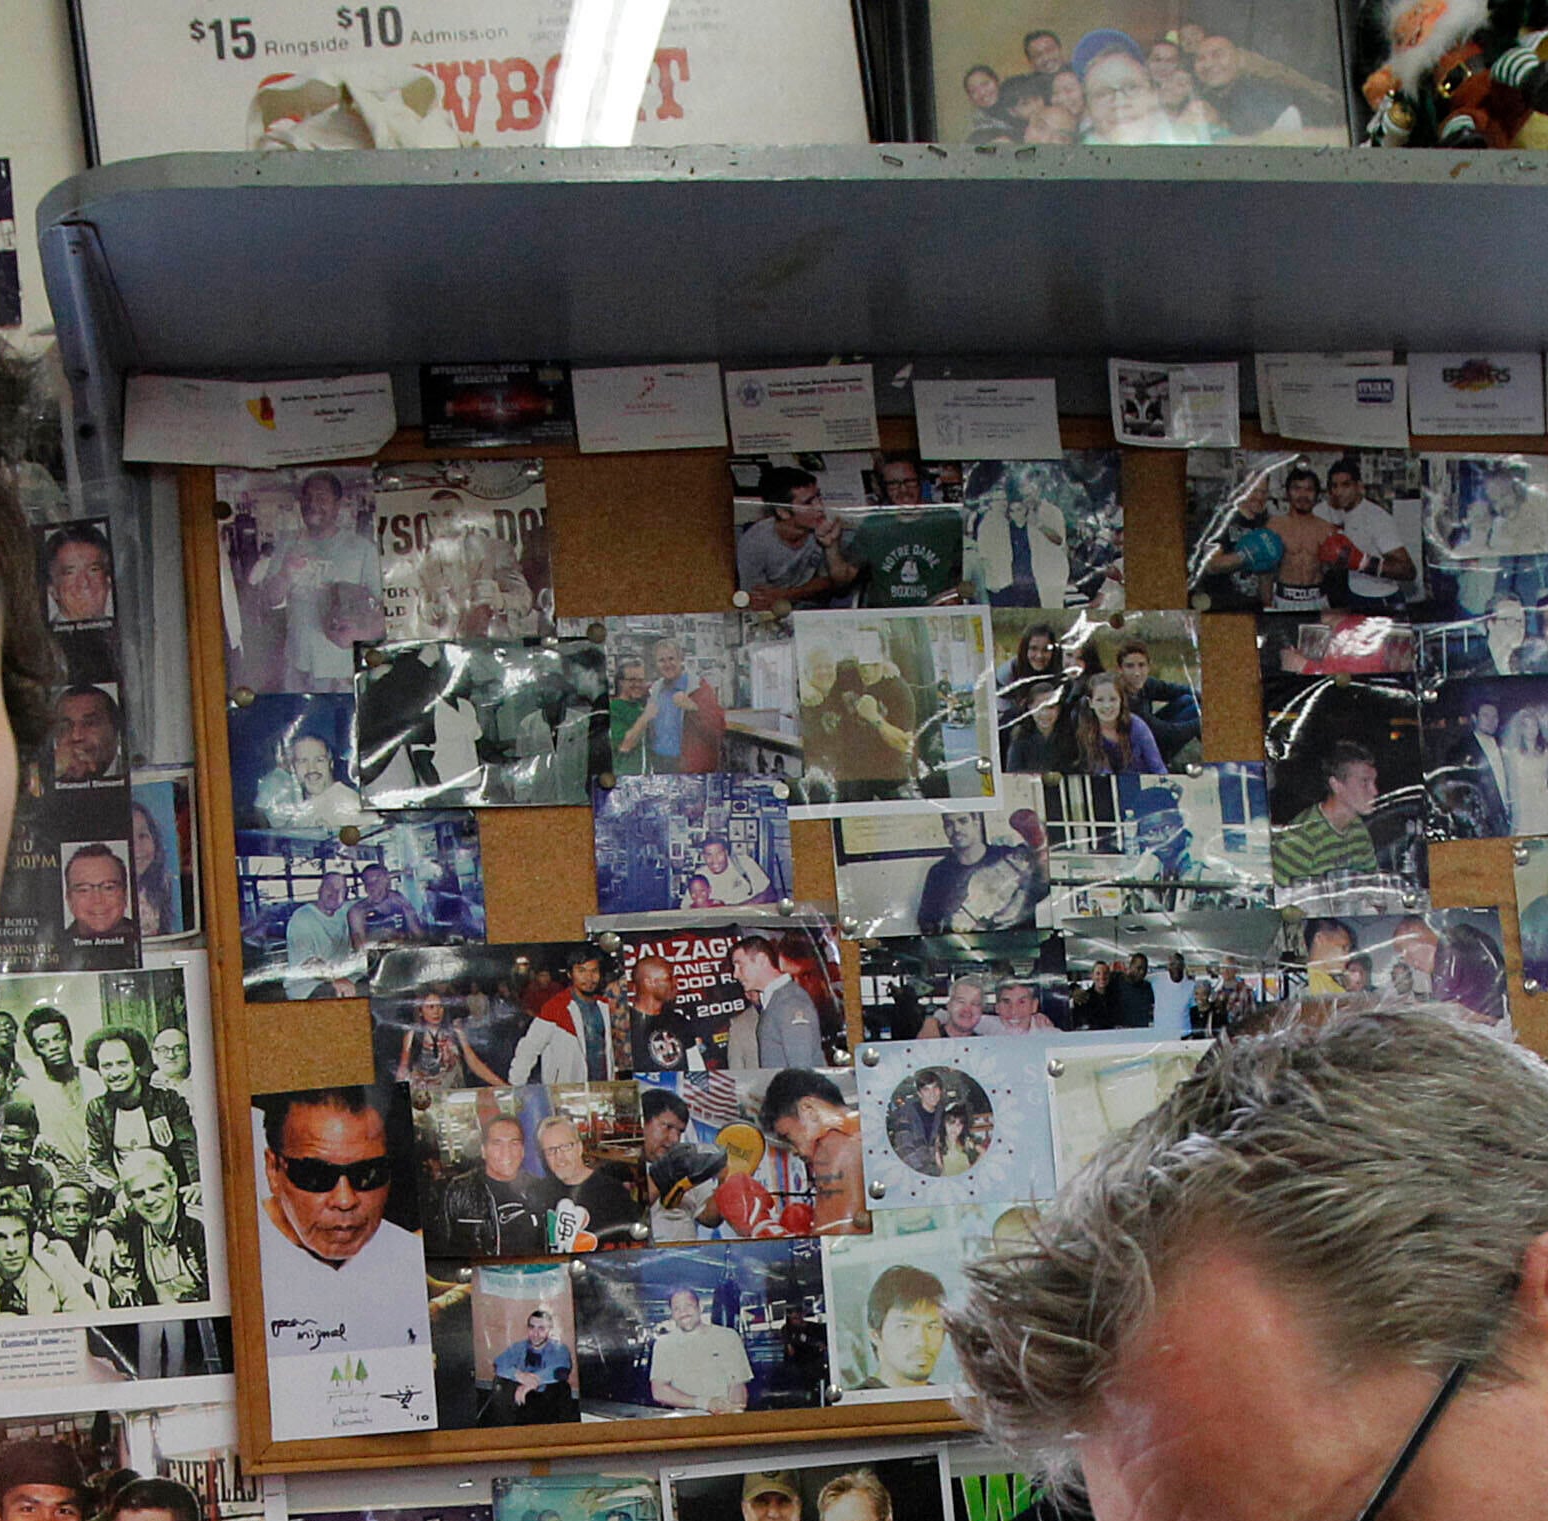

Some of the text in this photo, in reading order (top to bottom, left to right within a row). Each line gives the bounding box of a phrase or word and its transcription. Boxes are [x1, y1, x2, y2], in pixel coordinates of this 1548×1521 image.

[189, 4, 508, 61] $15 Ringside $10 Admission
[73, 936, 125, 947] Tom Arnold
[696, 998, 746, 1018] 2008
